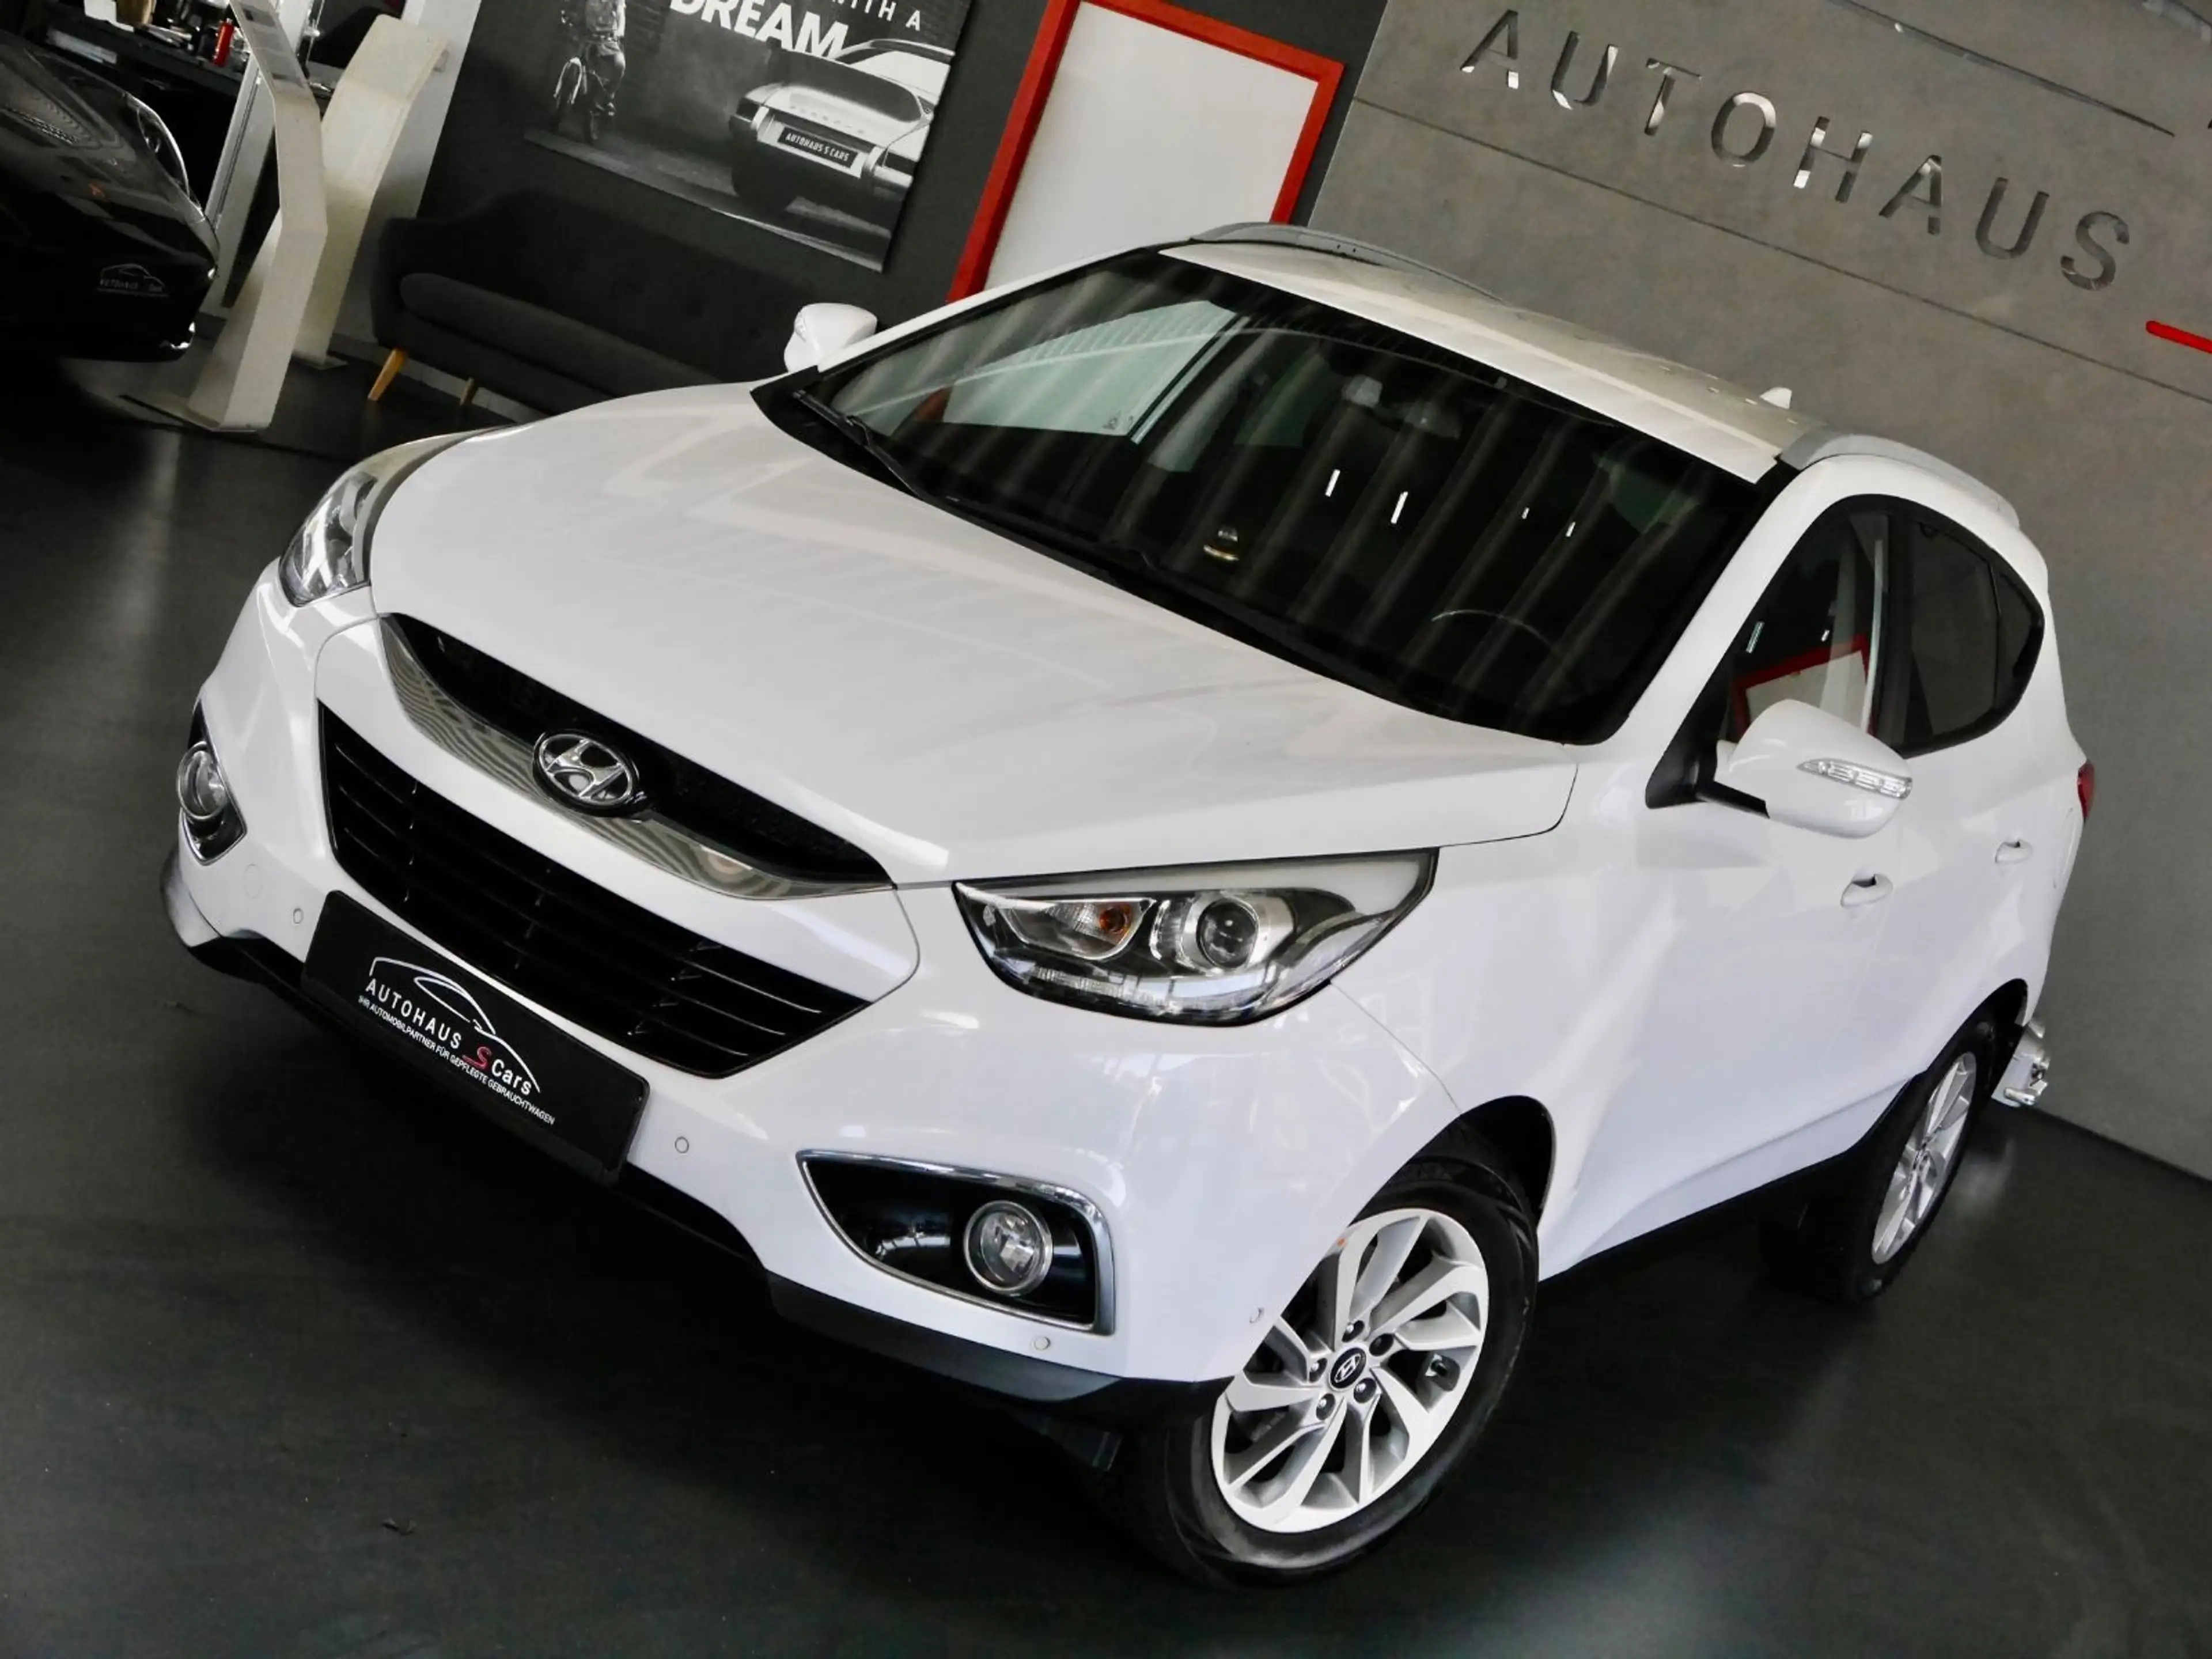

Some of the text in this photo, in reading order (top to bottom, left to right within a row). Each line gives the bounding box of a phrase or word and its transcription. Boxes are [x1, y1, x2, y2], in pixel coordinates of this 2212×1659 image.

[906, 9, 921, 31] A
[785, 132, 823, 151] AUTOHAUS
[830, 148, 850, 161] CARS
[1460, 10, 2130, 291] AUTOHAUS
[366, 978, 461, 1049] AUTOHAUS
[492, 1059, 532, 1095] Cars
[369, 1003, 437, 1052] AUTOMOBILPARTNER
[435, 1044, 450, 1060] FÜR
[449, 1054, 489, 1085] GEPFLEGTE
[487, 1079, 555, 1124] GEBRAUCHTWAGEN
